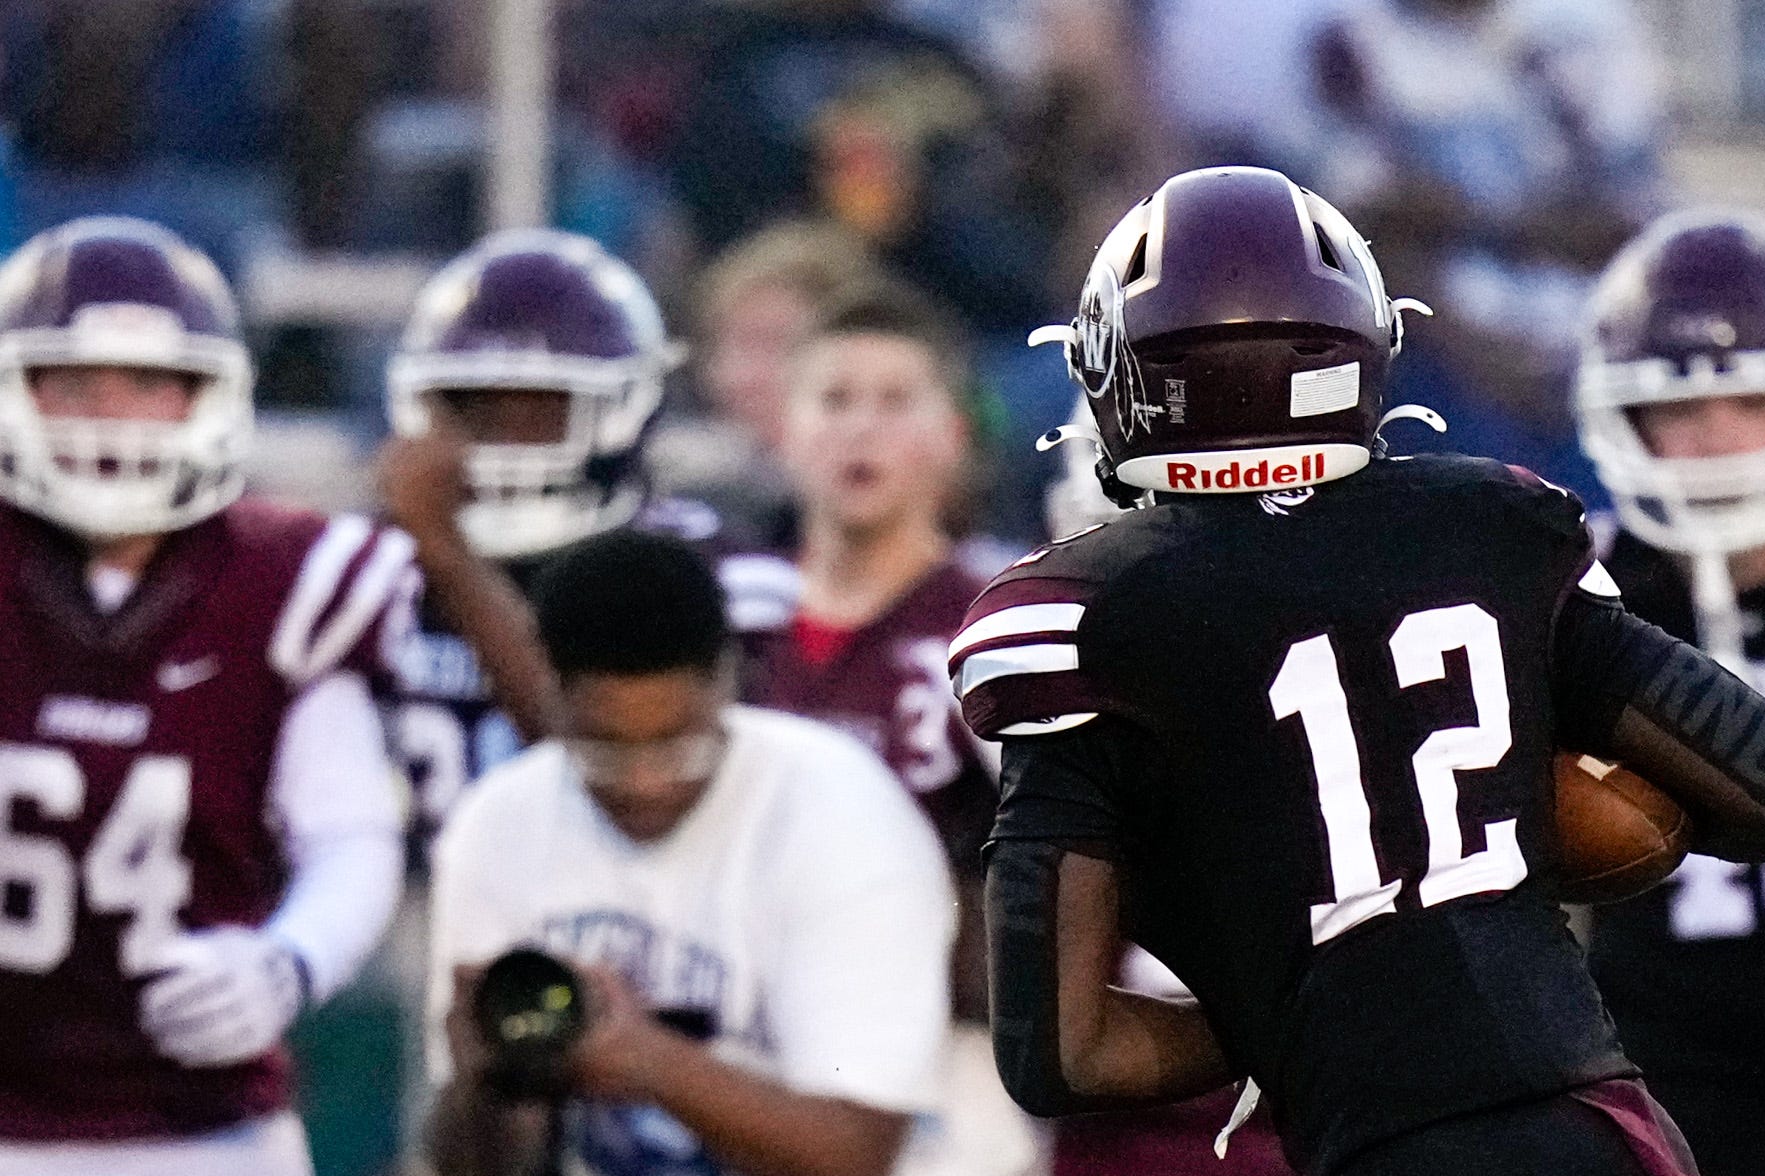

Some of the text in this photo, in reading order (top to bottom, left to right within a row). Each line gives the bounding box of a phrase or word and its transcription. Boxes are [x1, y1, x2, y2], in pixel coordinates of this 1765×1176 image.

[1167, 453, 1325, 490] Riddell
[0, 741, 194, 979] 64
[1268, 602, 1528, 946] 12
